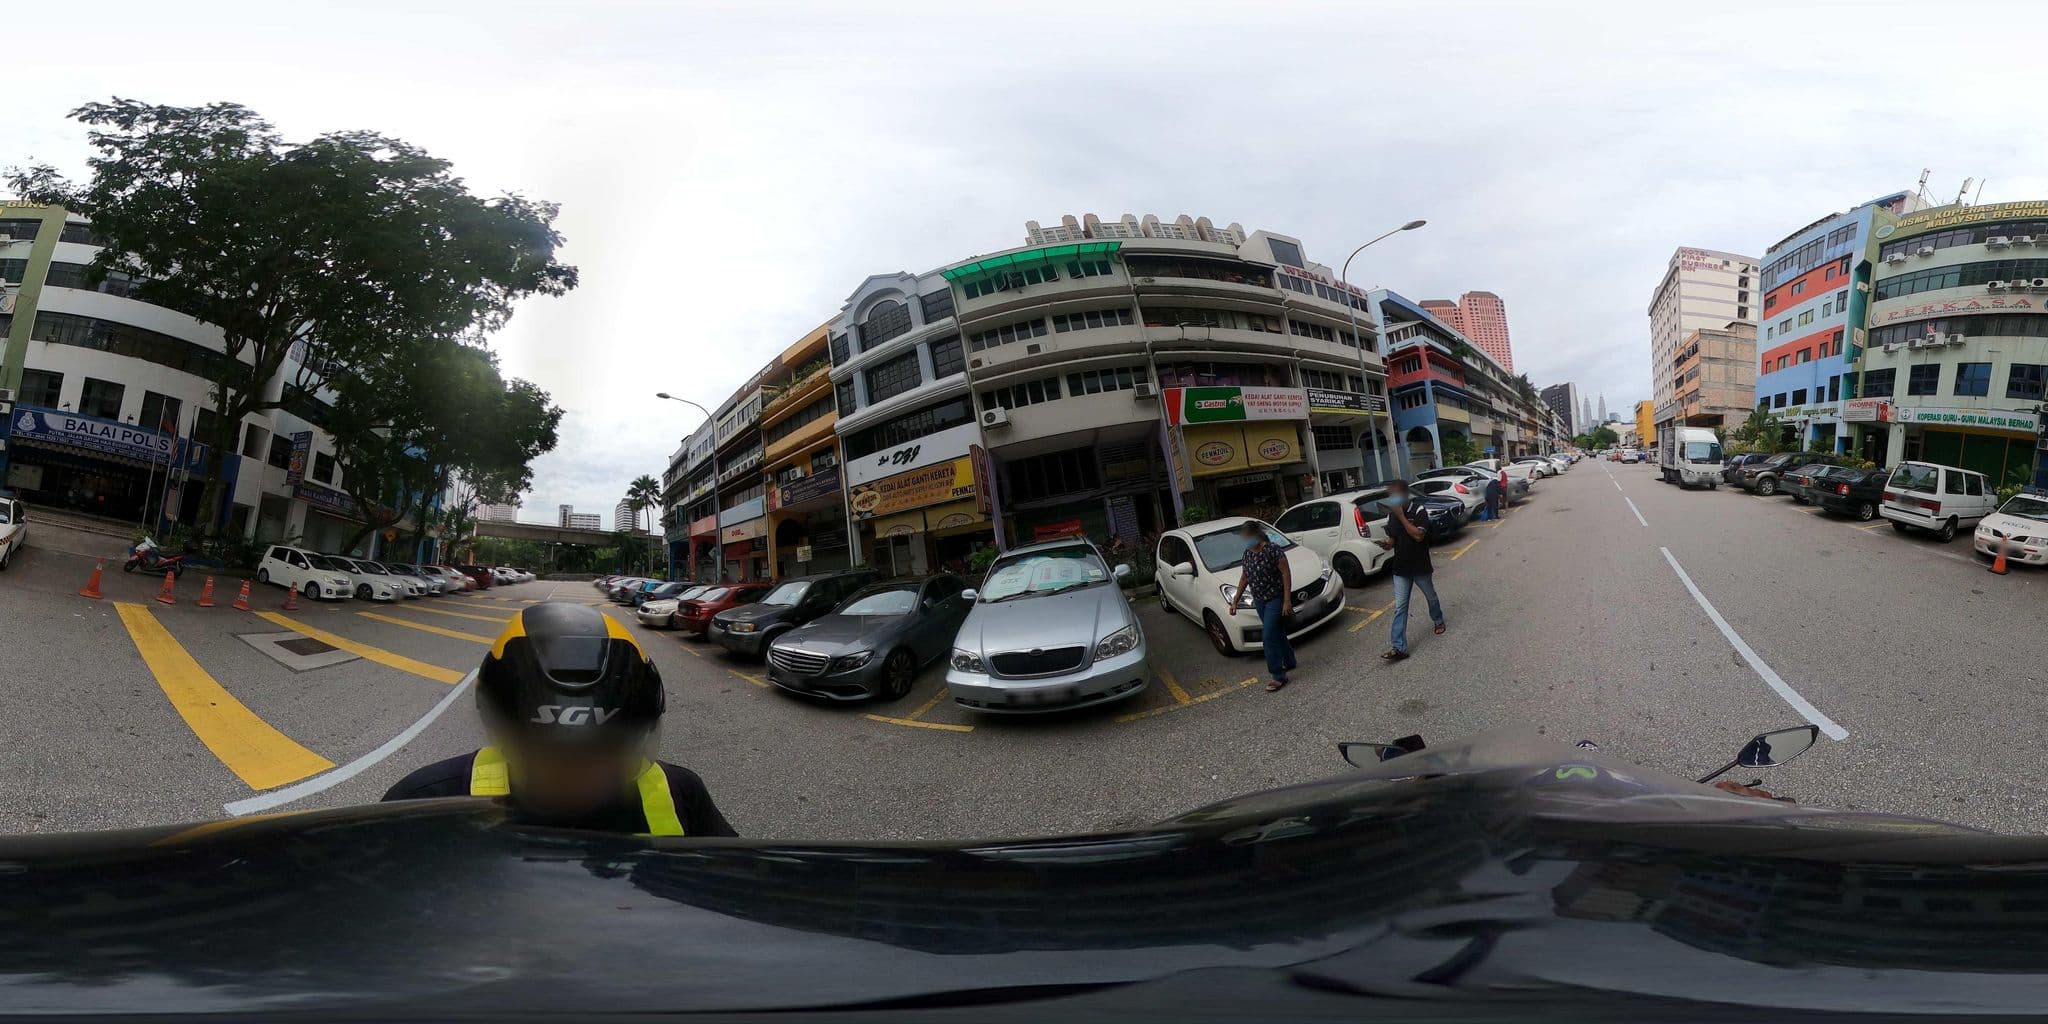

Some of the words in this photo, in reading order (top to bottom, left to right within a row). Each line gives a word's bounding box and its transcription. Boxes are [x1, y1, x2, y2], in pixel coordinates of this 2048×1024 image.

[1896, 216, 1930, 229] WISMA
[1935, 204, 2000, 220] KOPERASI
[2004, 201, 2046, 210] GURU
[1926, 212, 1986, 229] MALAYSIA
[1887, 297, 2032, 319] PERKASA
[1203, 400, 1226, 409] Castrol
[1917, 412, 1942, 421] KOPERASI
[1943, 413, 1957, 421] GURU
[1977, 416, 2007, 426] MALAYSIA
[2008, 418, 2034, 429] BERHAD
[64, 418, 117, 440] BALAI
[121, 429, 169, 451] POLIS
[1201, 447, 1230, 460] PENNZOIL
[1262, 444, 1286, 456] PENNZOIL
[929, 467, 956, 481] KERETA
[529, 704, 622, 726] SGV
